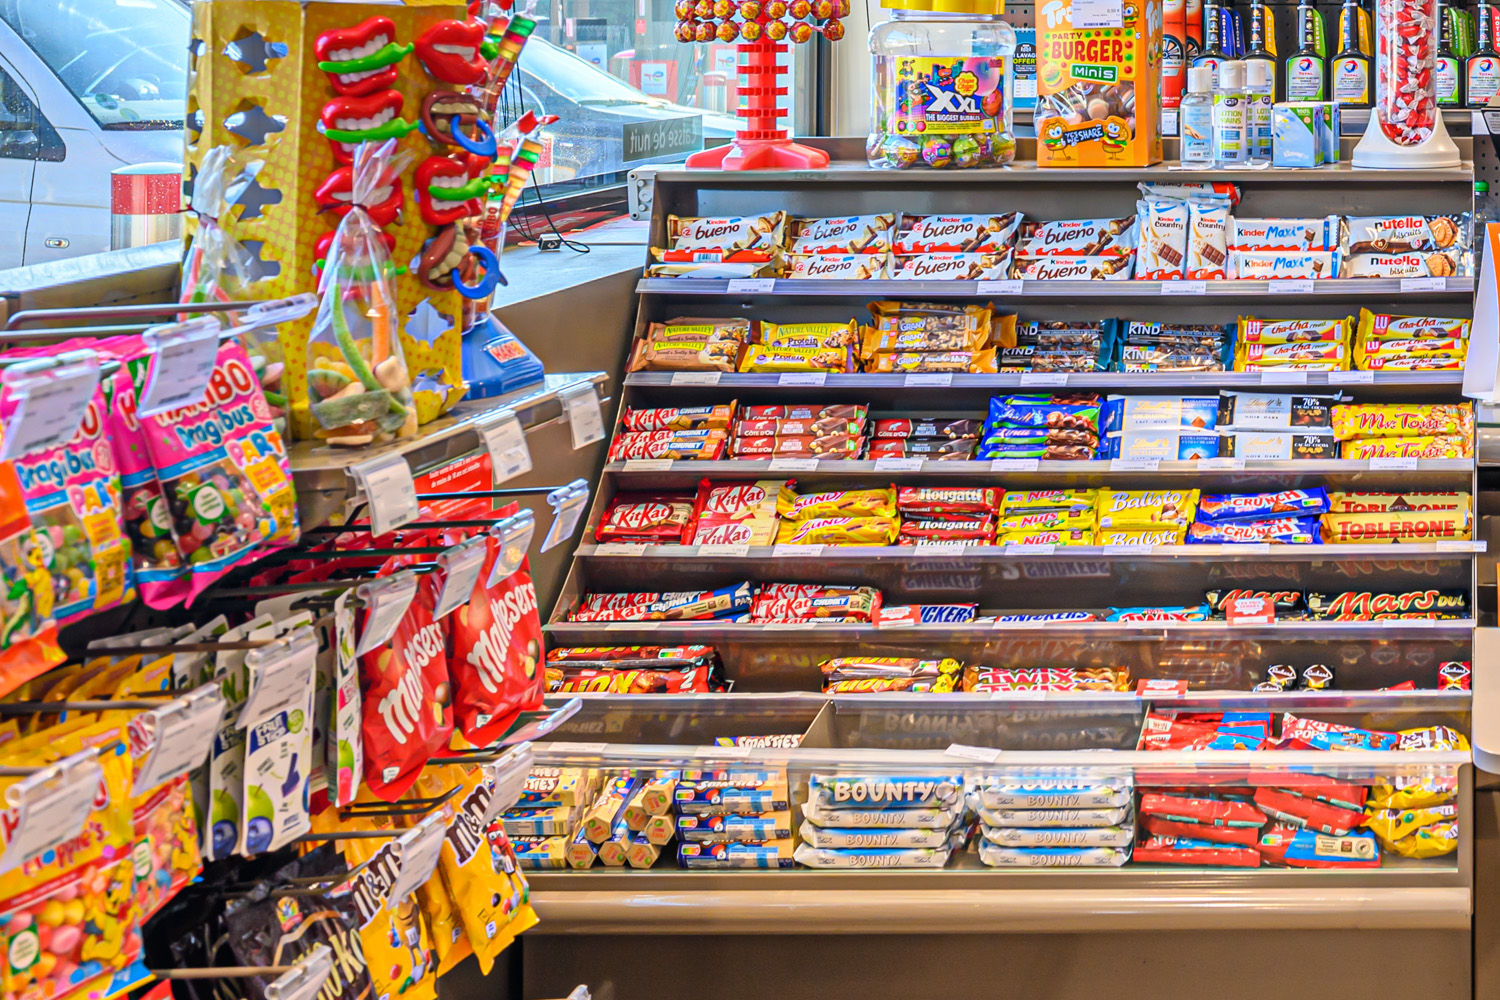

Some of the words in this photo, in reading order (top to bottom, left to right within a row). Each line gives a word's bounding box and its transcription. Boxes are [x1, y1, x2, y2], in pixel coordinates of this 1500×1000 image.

[1052, 40, 1123, 62] BURGER
[1075, 68, 1113, 79] Minis
[926, 86, 980, 114] XXL
[922, 222, 973, 238] bueno
[1155, 221, 1184, 232] Country
[1266, 225, 1296, 239] Maxi
[1374, 218, 1423, 232] nutella
[1393, 229, 1421, 240] biscuits
[913, 259, 966, 275] bueno
[1129, 323, 1160, 335] KIND
[1247, 321, 1260, 335] LU
[788, 337, 817, 346] Protein
[1302, 397, 1320, 407] 70%
[633, 408, 678, 429] KitKat
[1400, 412, 1441, 430] Tom
[711, 486, 765, 507] KitKat
[1112, 491, 1181, 510] Balisto
[1232, 489, 1301, 509] CRUNCH
[1338, 521, 1456, 538] TOBLERONE
[1328, 590, 1436, 615] Mars
[835, 781, 935, 803] BOUNTY
[1027, 796, 1079, 808] BOUNTY
